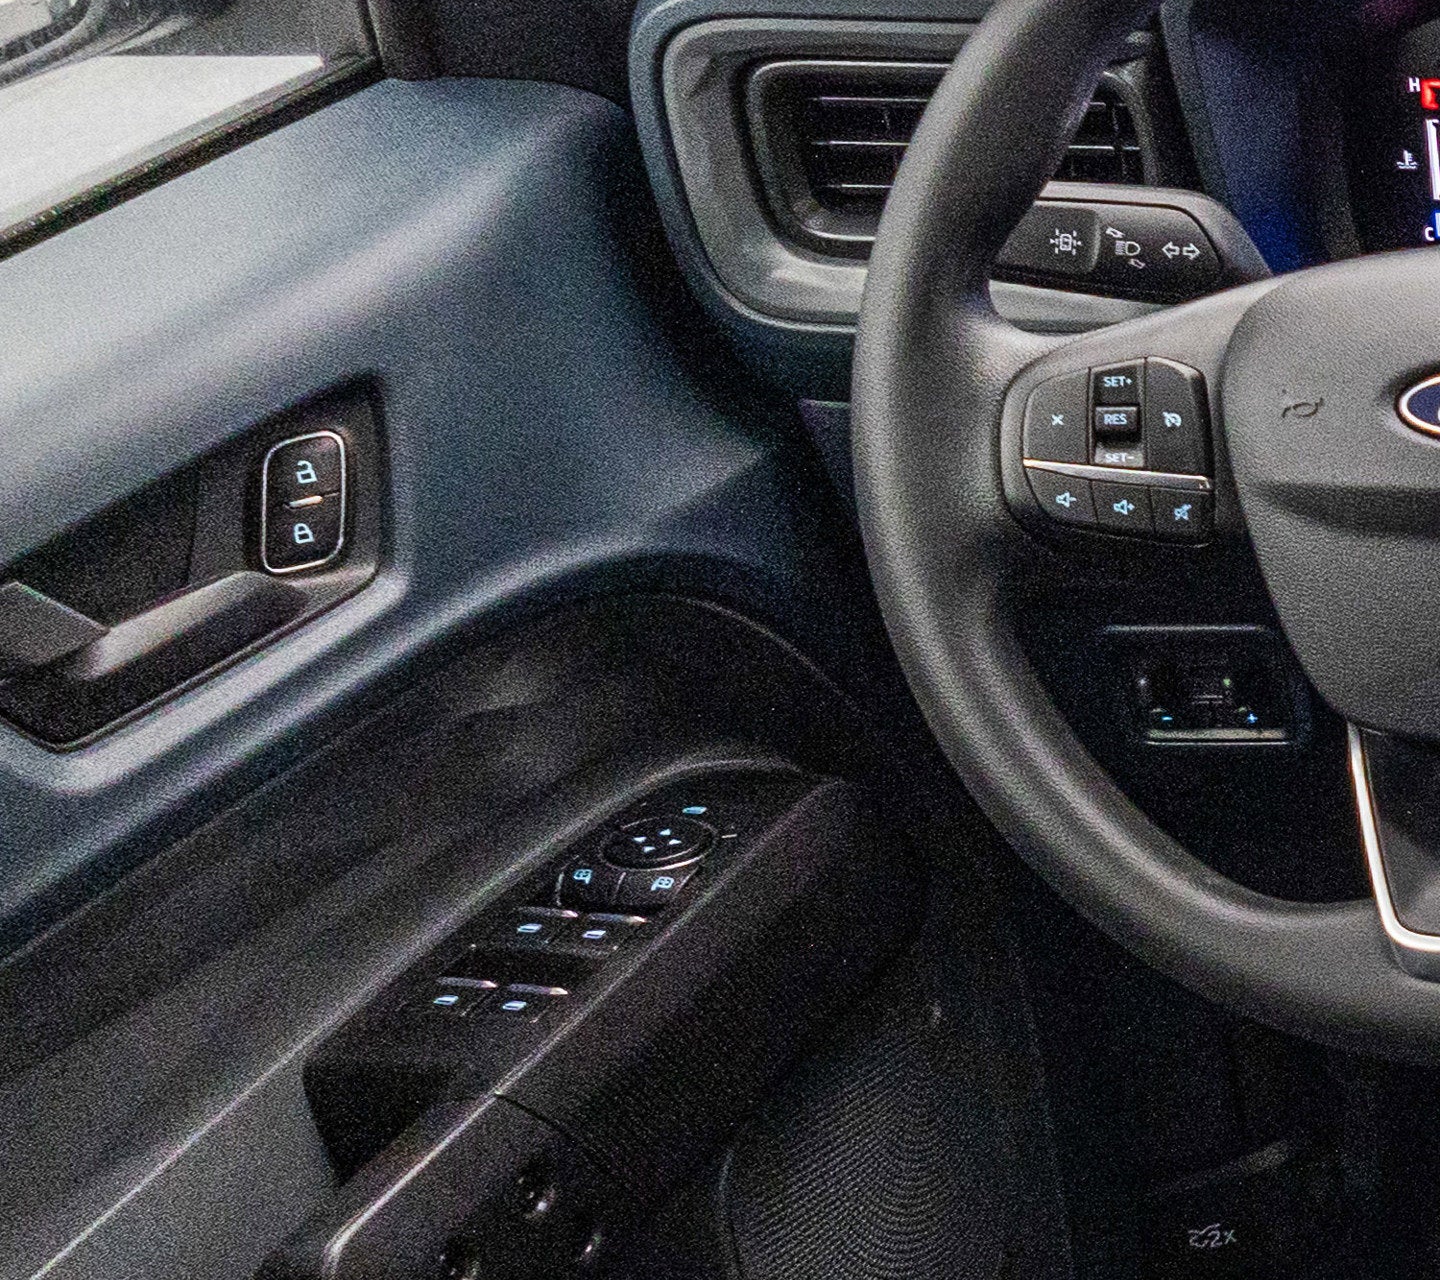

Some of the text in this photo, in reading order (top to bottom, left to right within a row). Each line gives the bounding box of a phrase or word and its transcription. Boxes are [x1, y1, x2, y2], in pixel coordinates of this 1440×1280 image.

[1408, 77, 1420, 93] H
[1424, 226, 1435, 241] C
[1103, 376, 1132, 387] SET+
[1104, 413, 1127, 425] RES
